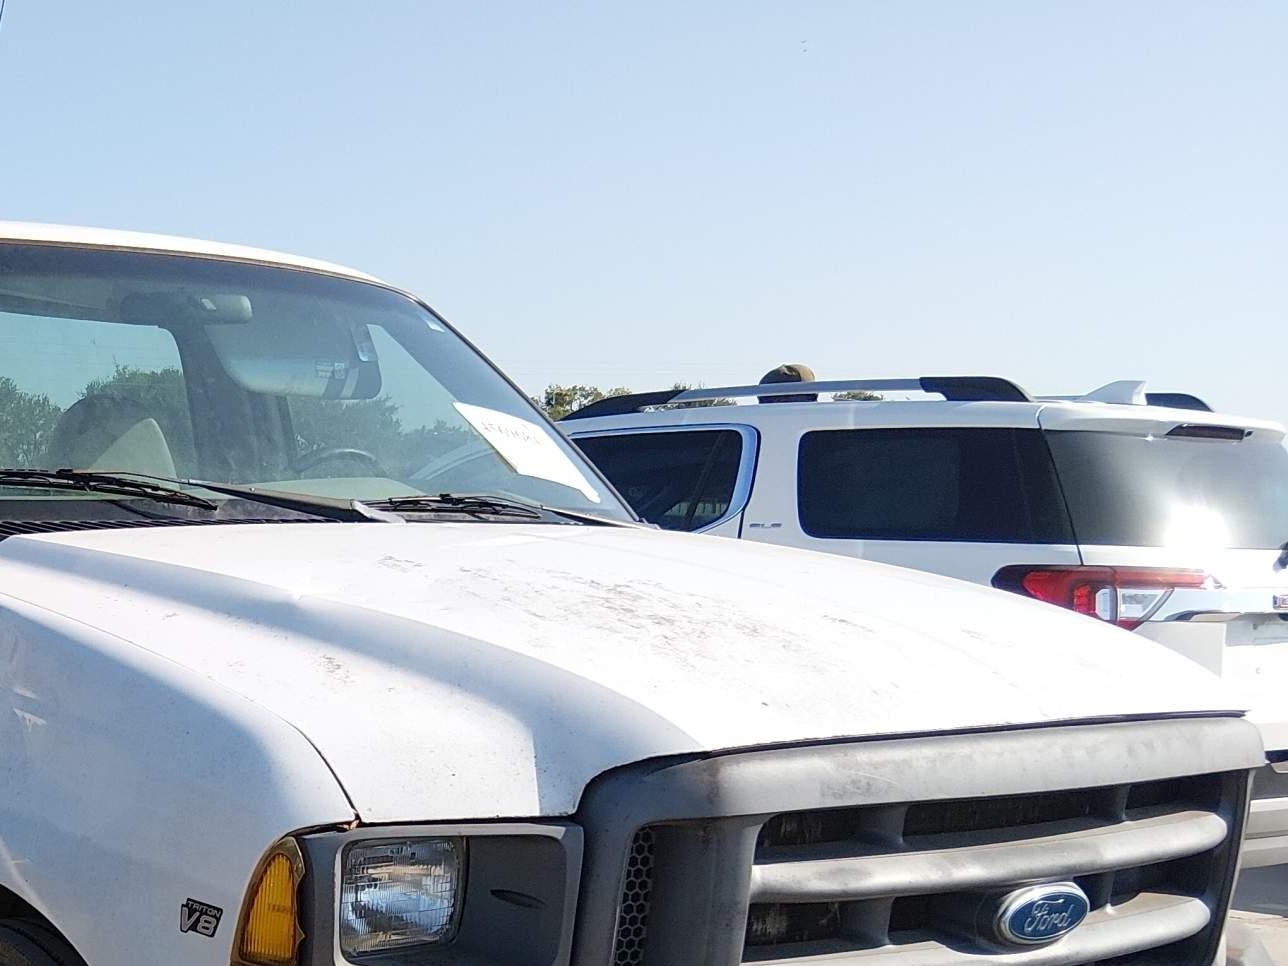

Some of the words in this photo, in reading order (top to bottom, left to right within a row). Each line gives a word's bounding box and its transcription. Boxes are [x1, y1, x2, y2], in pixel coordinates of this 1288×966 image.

[181, 907, 218, 935] V8
[187, 901, 222, 918] TRITON
[1023, 899, 1075, 934] Ford
